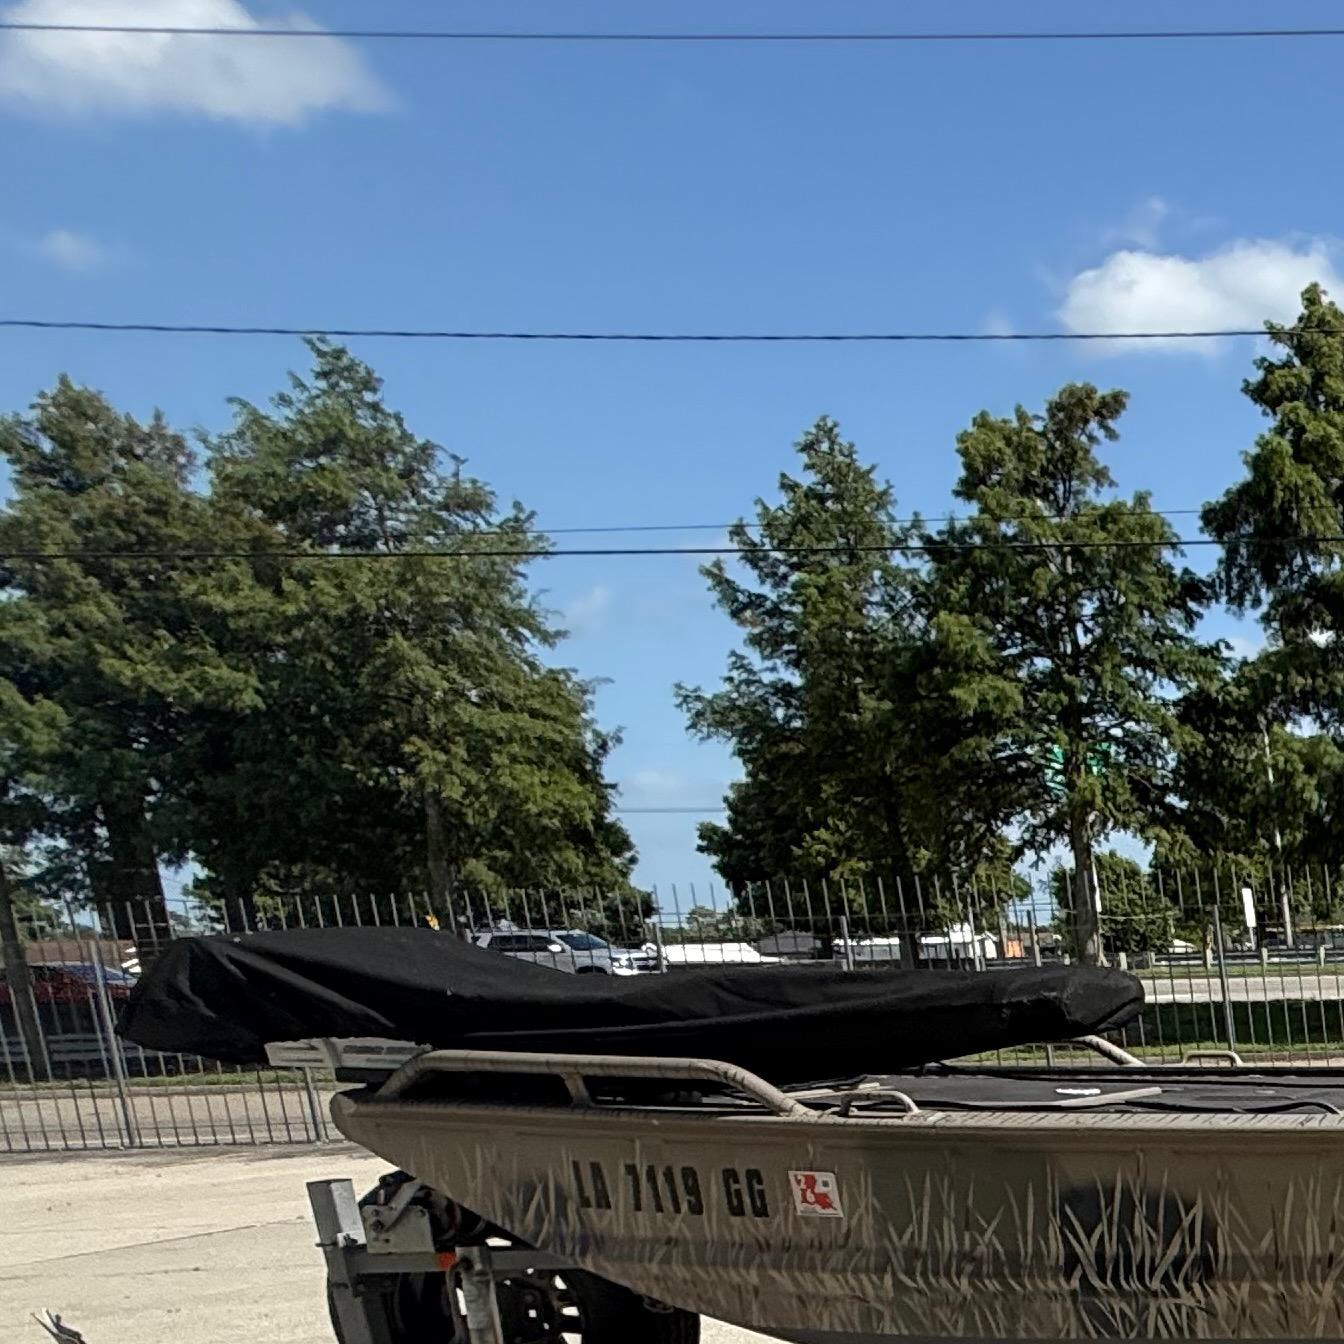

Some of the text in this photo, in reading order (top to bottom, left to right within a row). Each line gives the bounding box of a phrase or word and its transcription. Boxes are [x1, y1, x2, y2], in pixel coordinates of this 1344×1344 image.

[571, 1159, 770, 1218] LA 7119 GG
